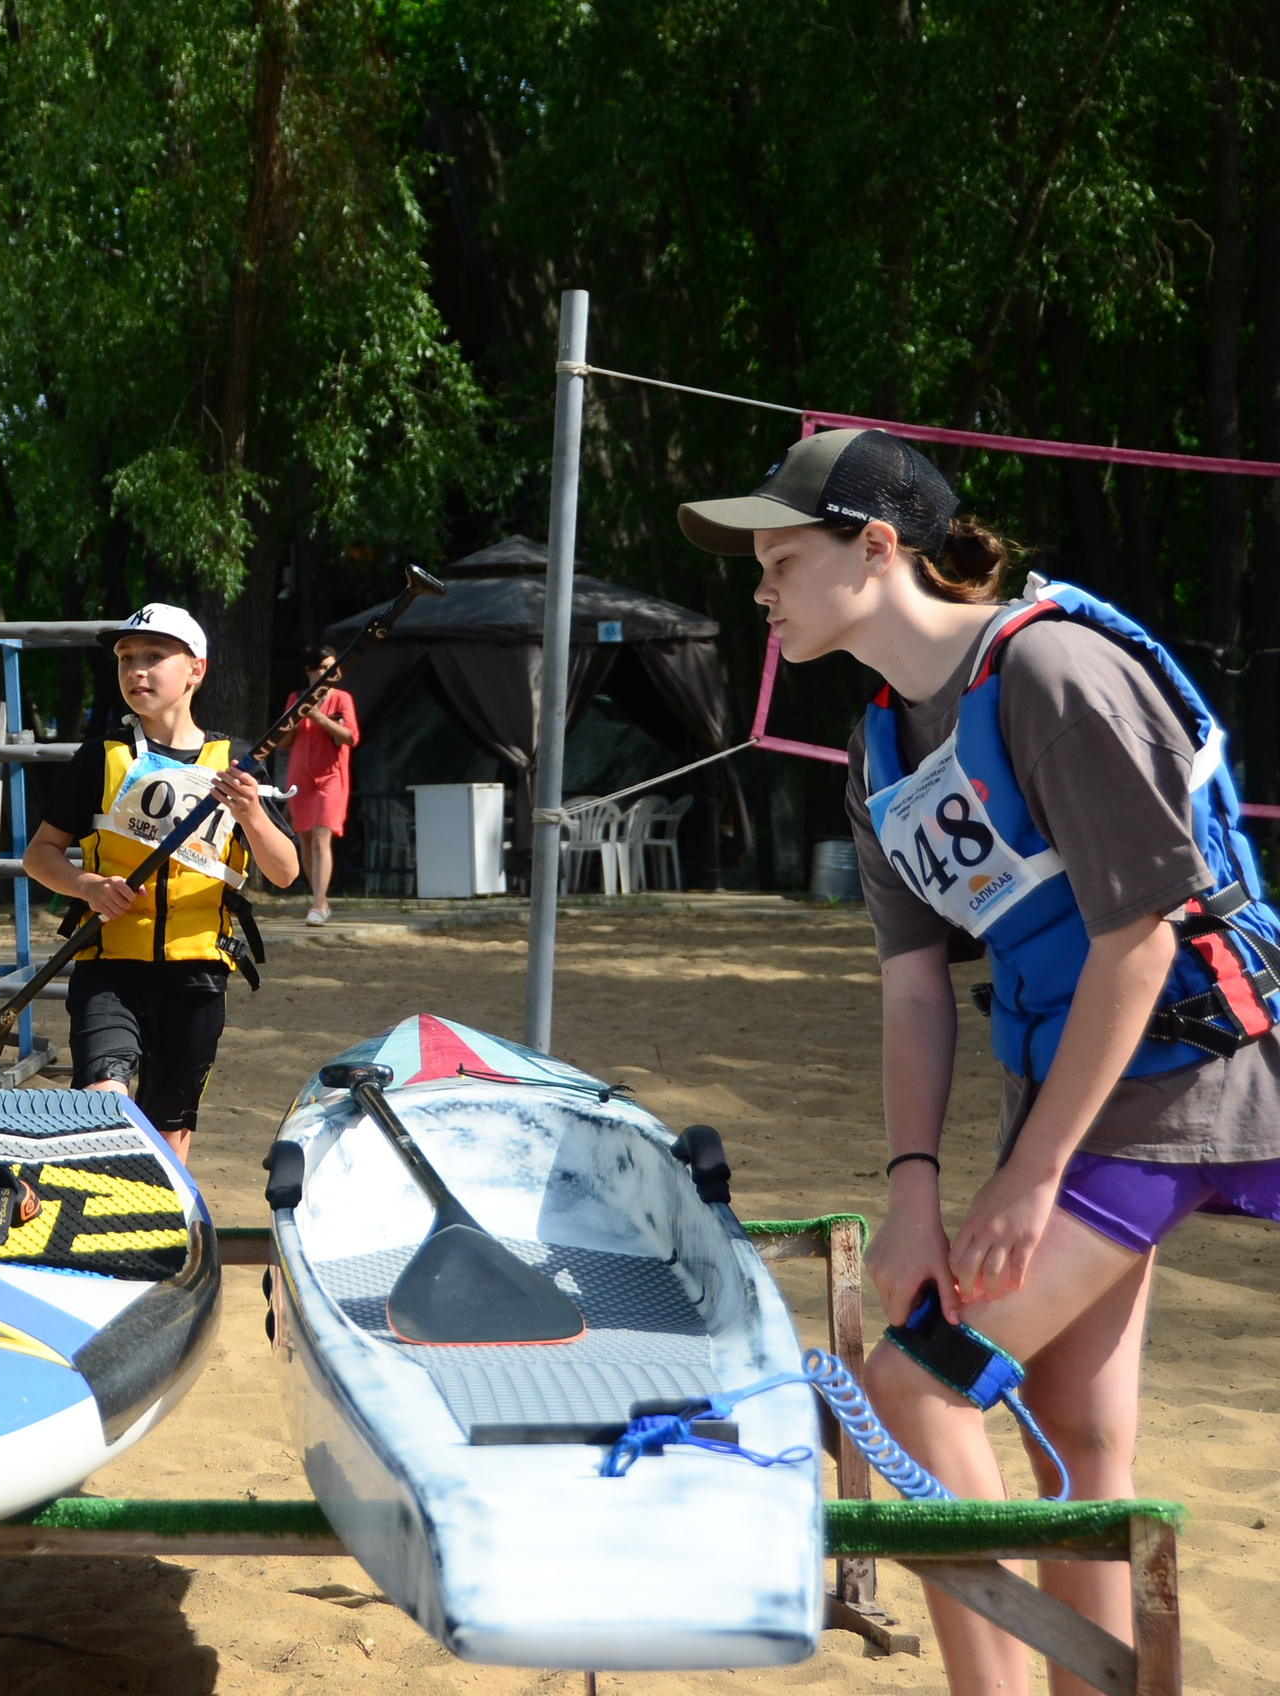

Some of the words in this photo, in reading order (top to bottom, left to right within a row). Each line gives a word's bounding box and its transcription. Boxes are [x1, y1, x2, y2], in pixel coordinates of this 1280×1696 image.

[826, 503, 840, 512] IS
[841, 506, 868, 520] BORN
[279, 667, 344, 732] AQUA
[128, 817, 150, 832] SUP
[969, 871, 1013, 911] САПКЛАБ
